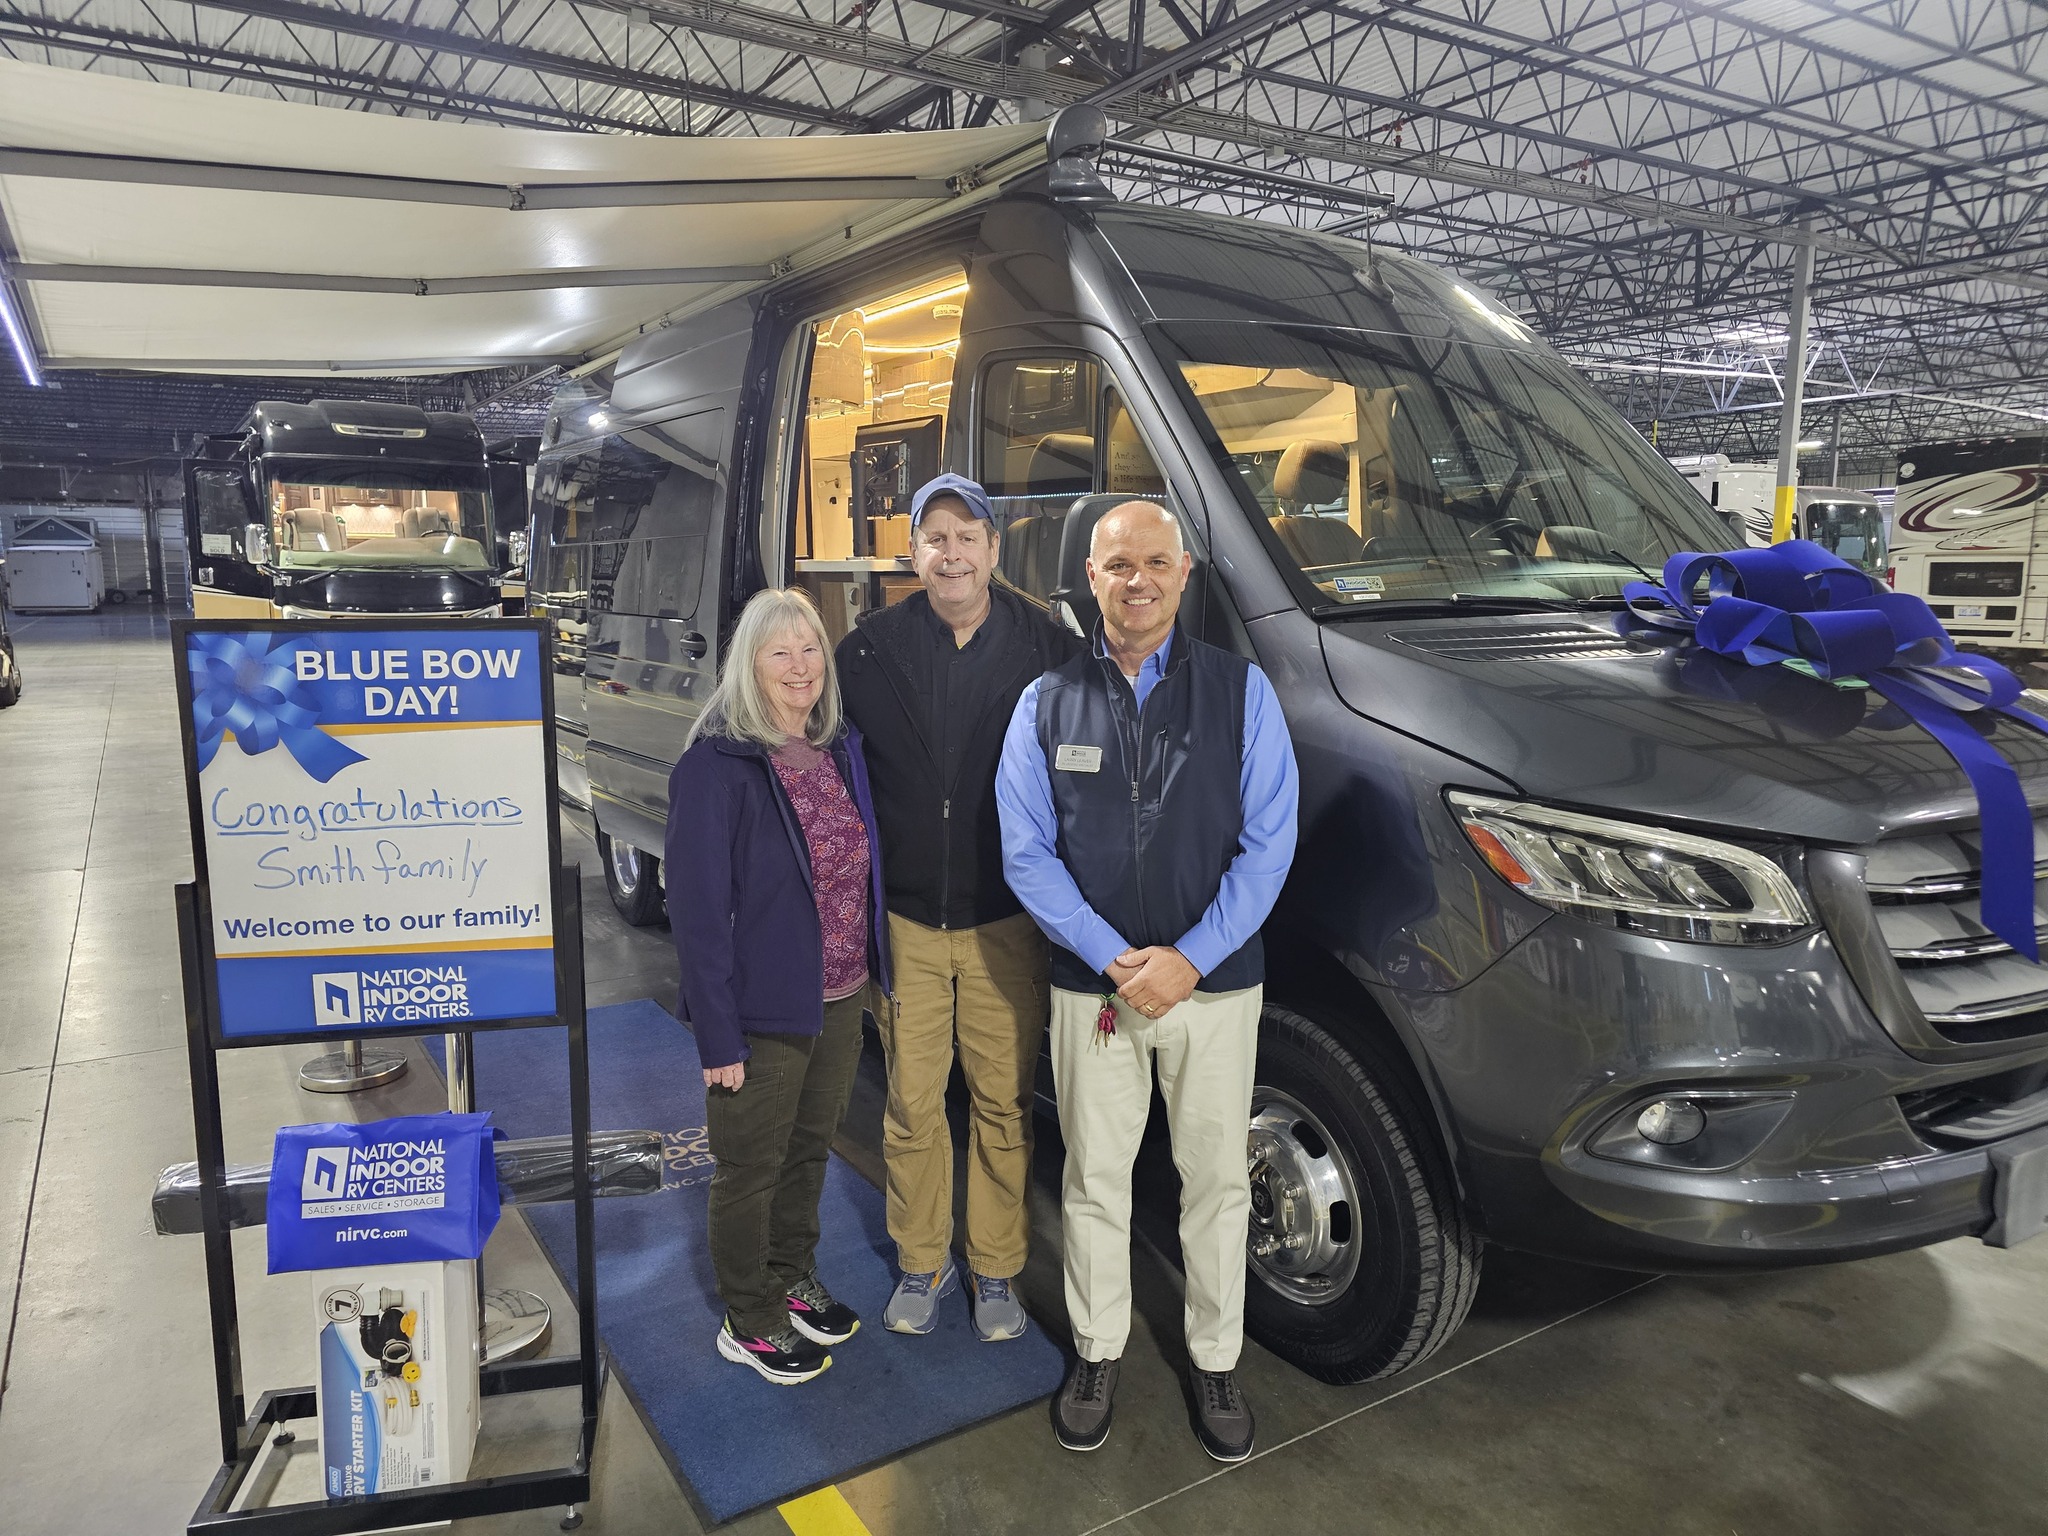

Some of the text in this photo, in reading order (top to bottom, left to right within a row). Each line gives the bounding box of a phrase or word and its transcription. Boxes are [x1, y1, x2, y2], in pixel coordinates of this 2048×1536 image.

[295, 648, 521, 681] BLUE BOW
[364, 685, 459, 716] DAY!
[211, 787, 523, 841] Congratulations
[253, 844, 365, 889] Smith
[223, 904, 542, 940] Welcome to our family!
[361, 965, 467, 988] NATIONAL
[362, 982, 469, 1007] INDOOR
[364, 1006, 388, 1023] RV
[351, 1138, 446, 1164] NATIONAL
[349, 1156, 445, 1182] INDOOR
[346, 1175, 445, 1199] RV CENTERS
[307, 1196, 440, 1215] SALES SERVICE STORAGE
[335, 1226, 408, 1243] nirvc.com
[334, 1299, 352, 1312] 7
[350, 1390, 366, 1495] RV STARTER KIT
[331, 1470, 339, 1492] CAMCO
[343, 1464, 354, 1497] Deluxe
